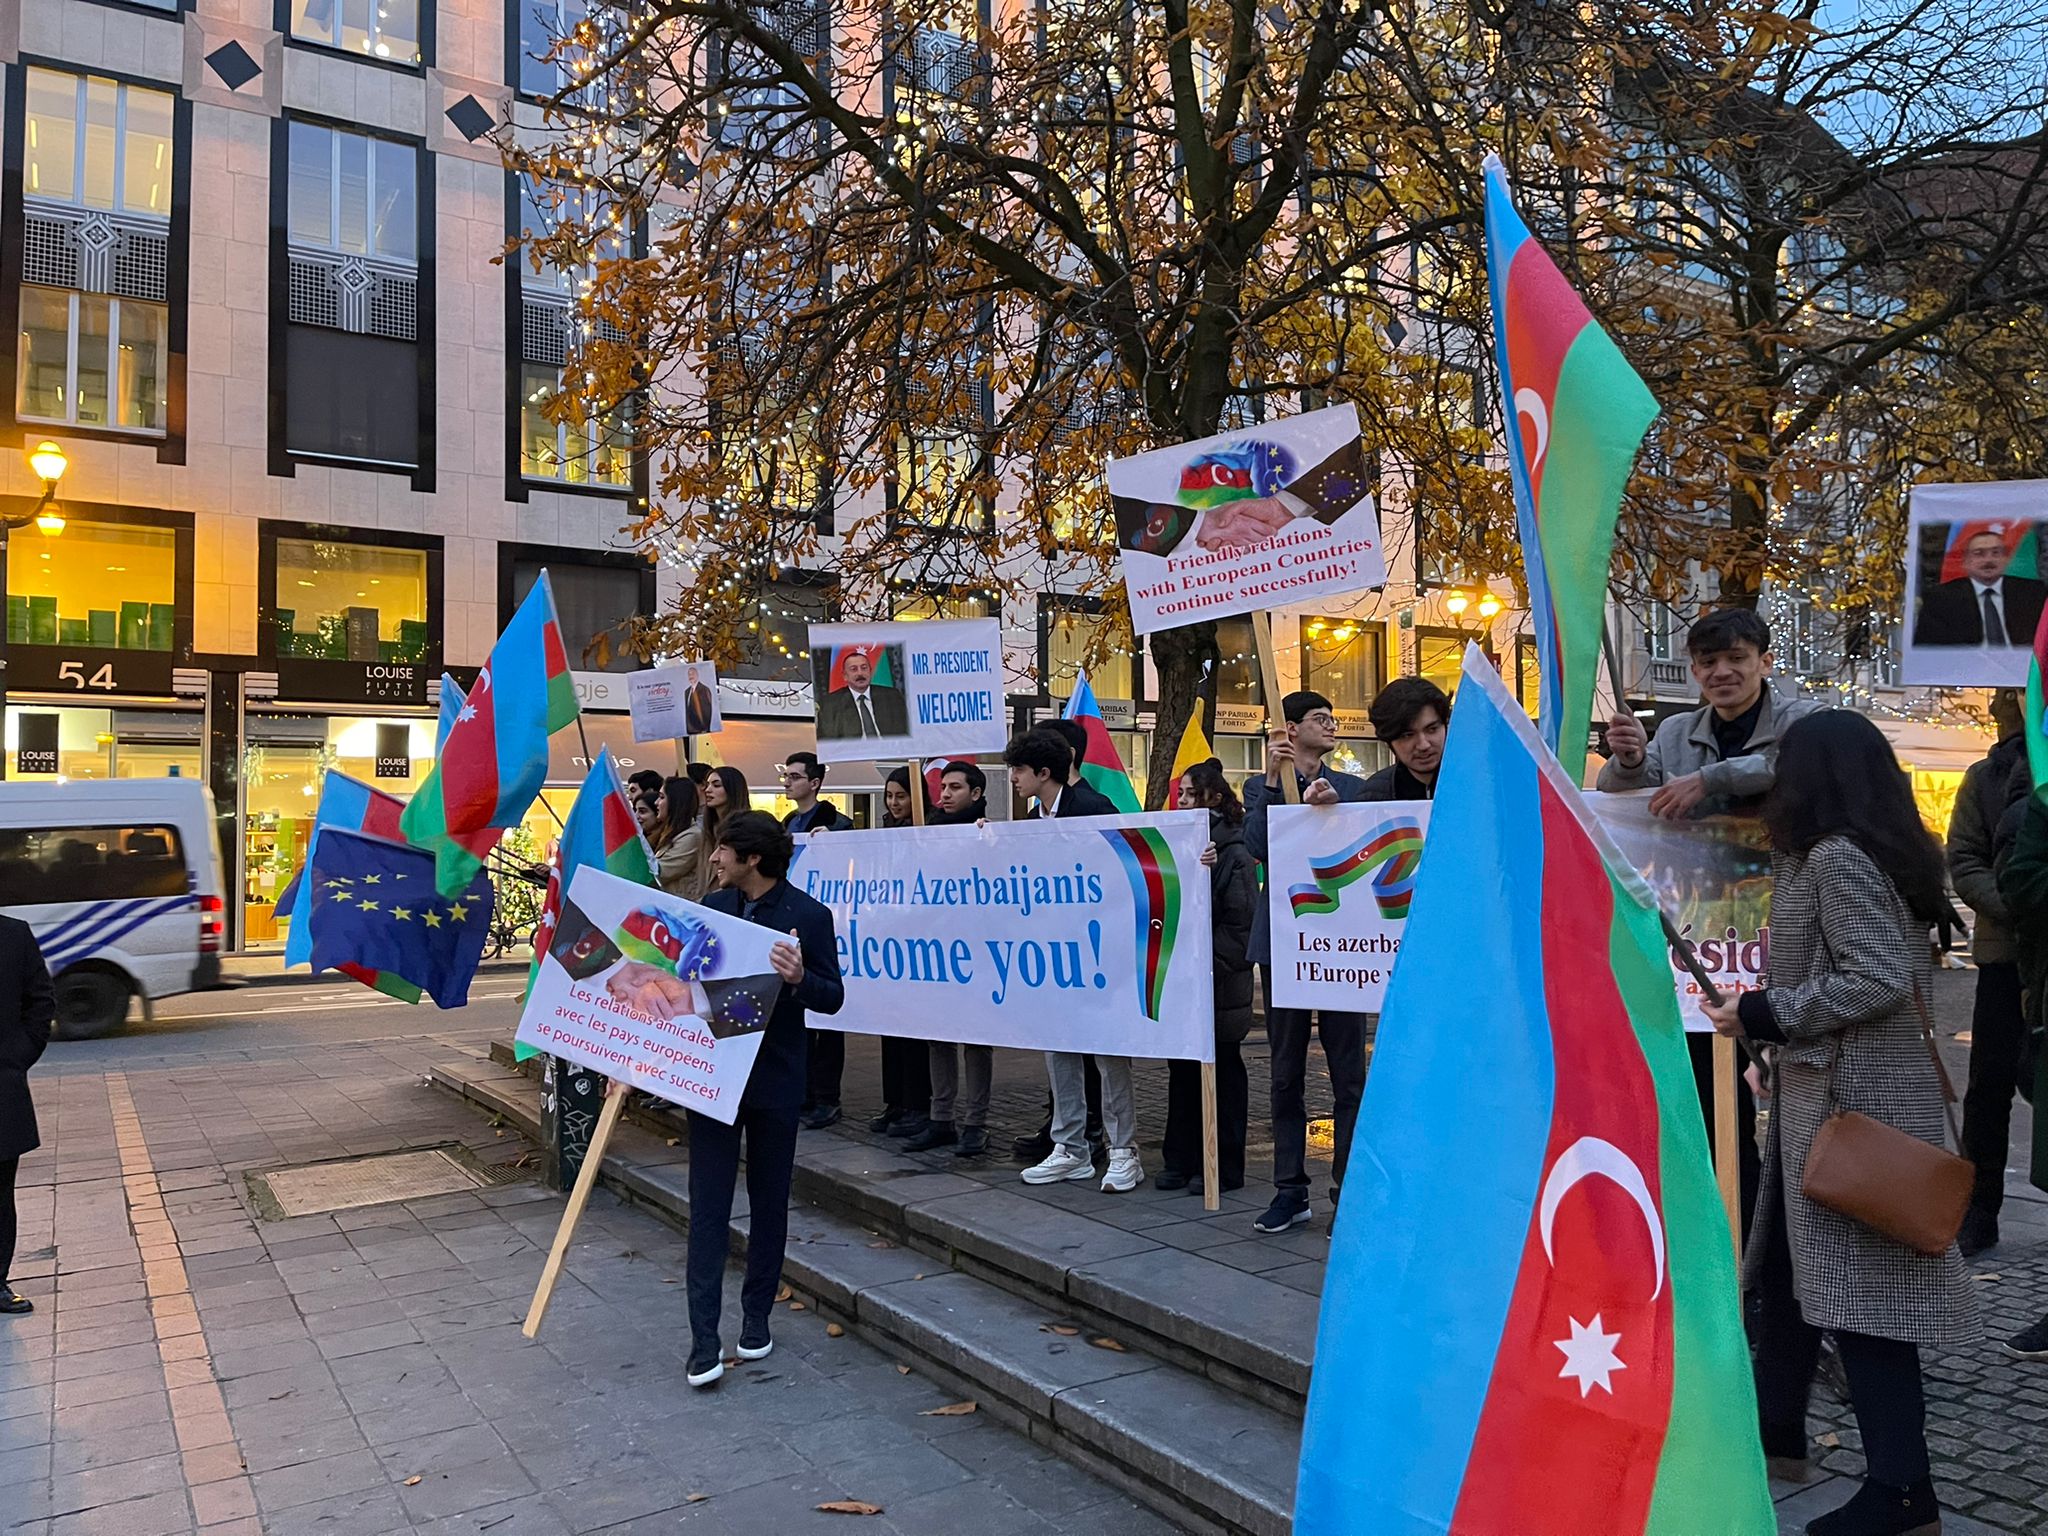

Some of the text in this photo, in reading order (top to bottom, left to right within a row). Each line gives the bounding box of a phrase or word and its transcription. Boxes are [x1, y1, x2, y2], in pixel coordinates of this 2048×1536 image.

[1166, 526, 1333, 573] Friendly relations
[1136, 539, 1373, 600] with European Countries
[1156, 559, 1358, 616] continue successfully!
[58, 661, 118, 690] 54
[366, 666, 414, 680] LOUISE
[912, 650, 992, 675] MR. PRESIDENT,
[366, 682, 413, 690] FIFTY
[366, 689, 413, 697] FOUR
[575, 680, 609, 702] aje
[746, 688, 801, 709] maje
[917, 690, 993, 725] WELCOME!
[1228, 711, 1258, 719] PARIBAS
[21, 751, 56, 760] LOUISE
[378, 758, 407, 766] LOUISE
[571, 755, 635, 768] mje
[806, 862, 1103, 917] European Azerbaijanis
[1298, 931, 1401, 954] Les azerba
[1671, 923, 1770, 974] ésid
[837, 919, 1107, 1006] elcome you!
[1296, 961, 1381, 989] l'Europe
[569, 983, 717, 1050] Les relations amicales
[555, 1004, 716, 1075] avec les pays européens
[536, 1021, 721, 1102] se poursuivent avec succès!
